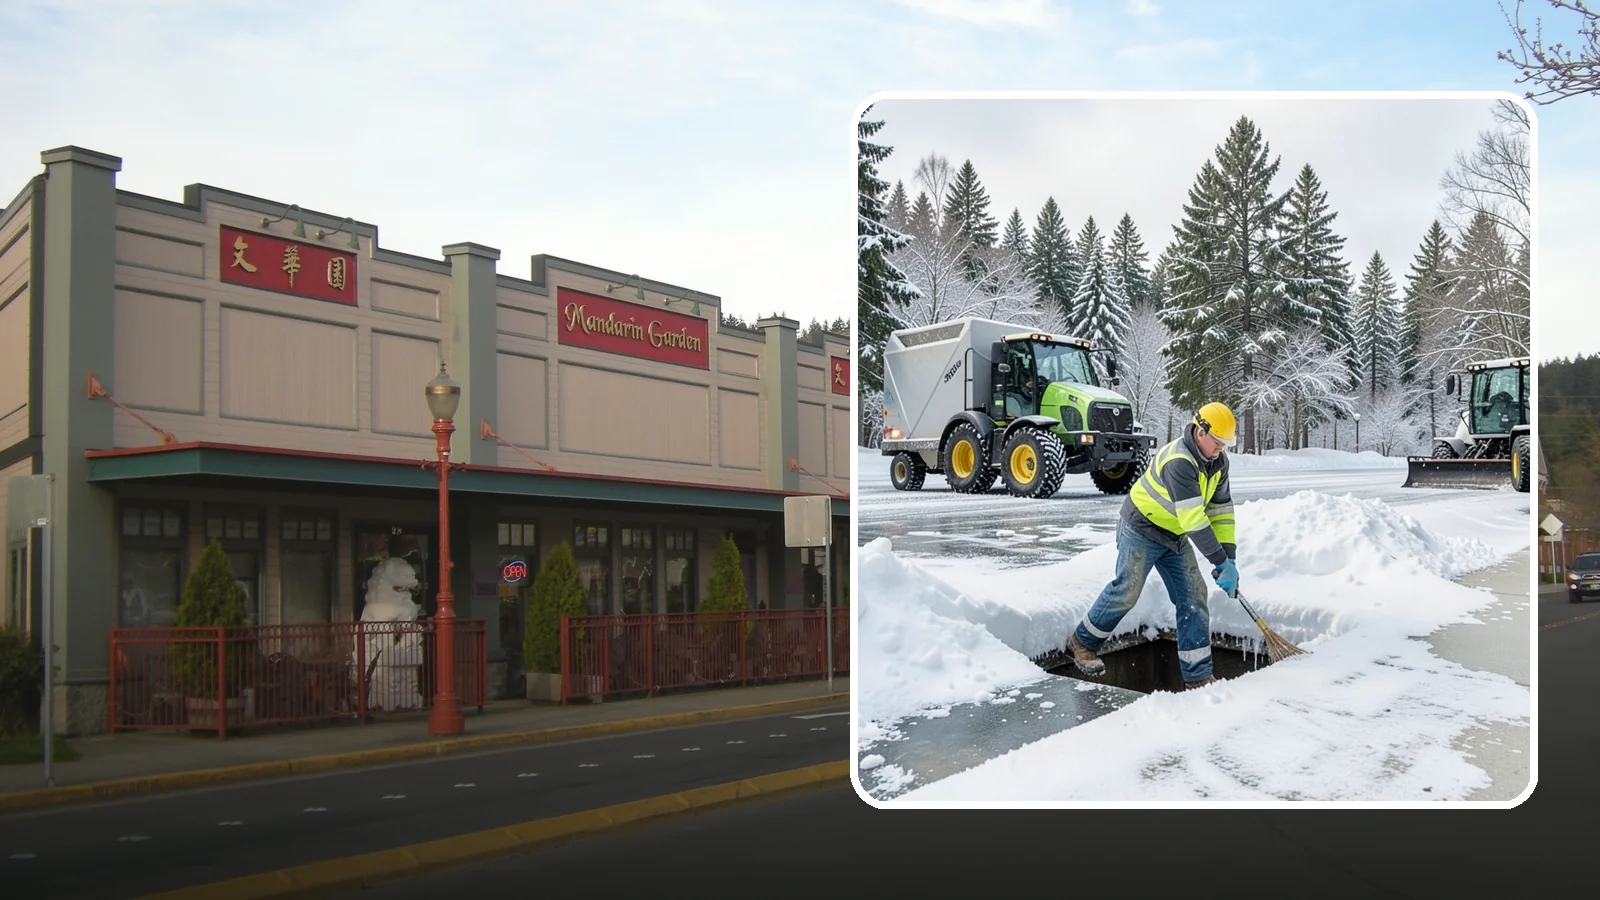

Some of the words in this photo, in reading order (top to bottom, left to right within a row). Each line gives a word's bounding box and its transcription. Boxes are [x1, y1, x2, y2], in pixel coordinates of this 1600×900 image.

[230, 236, 347, 290] 文華園
[564, 302, 644, 341] Mandarin
[647, 320, 702, 352] Garden
[503, 565, 527, 578] OPEN
